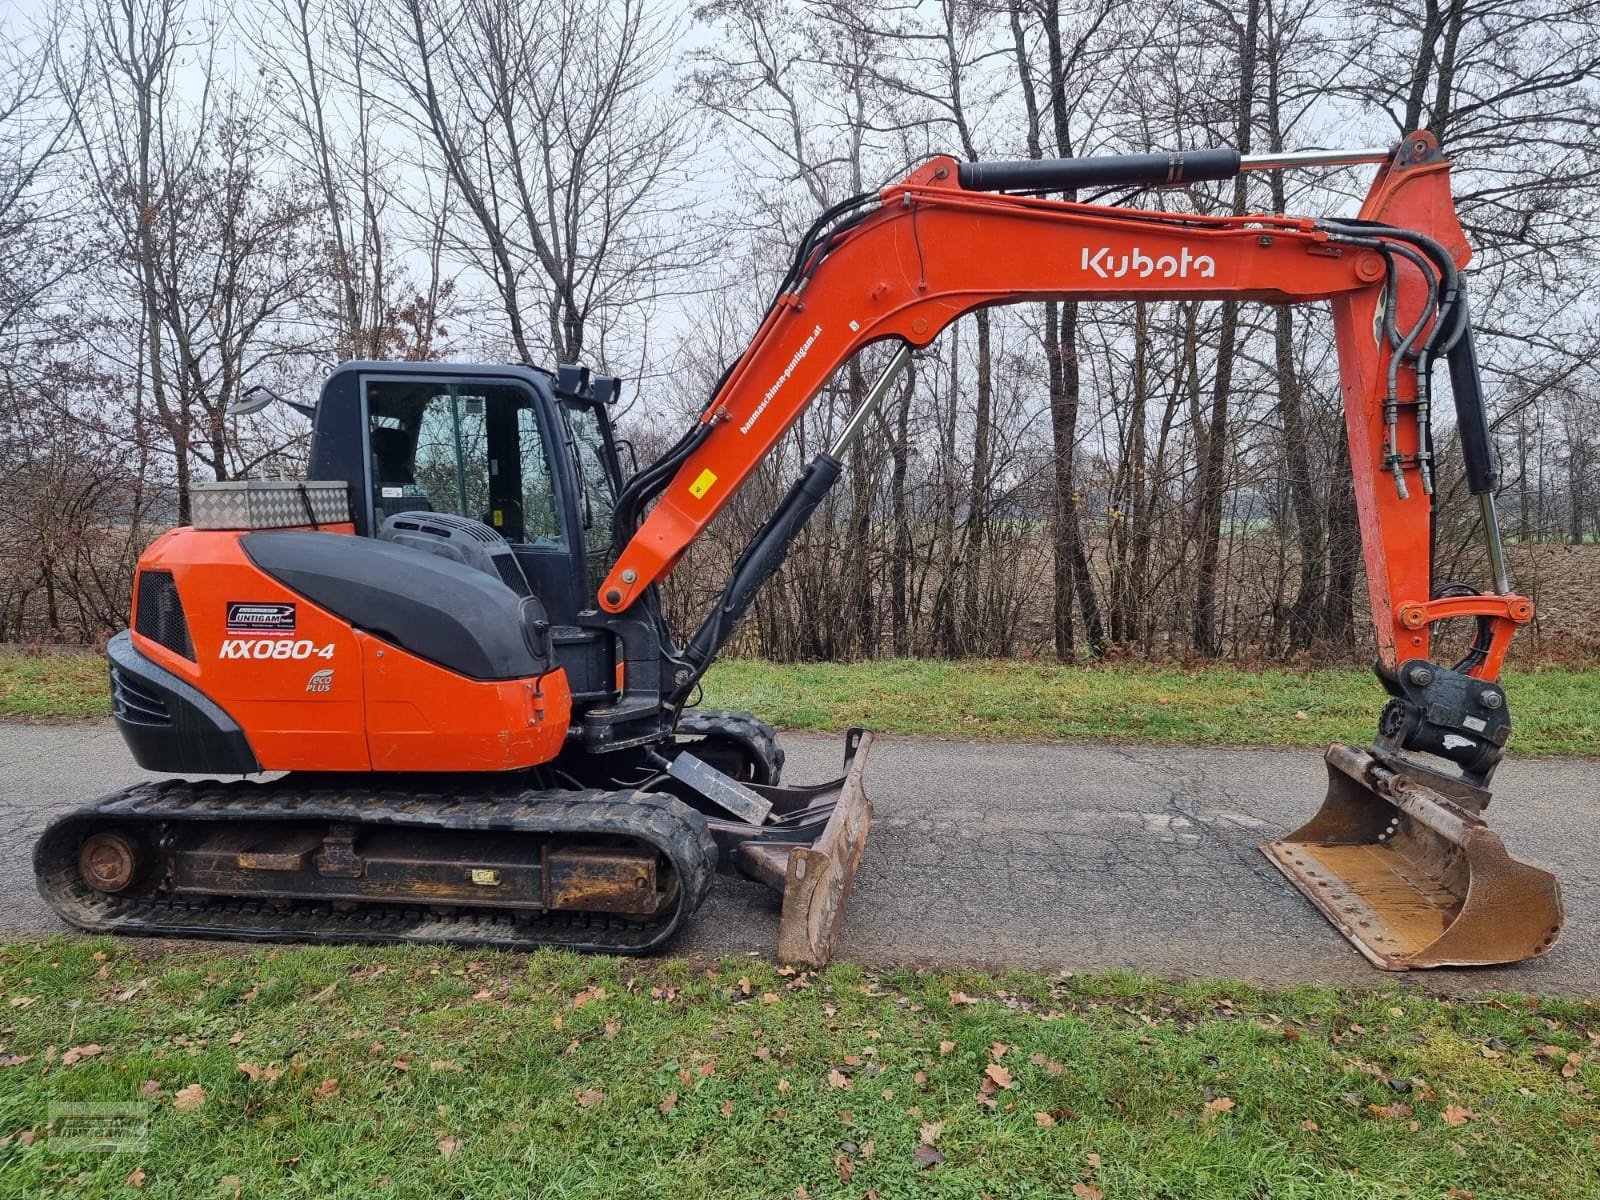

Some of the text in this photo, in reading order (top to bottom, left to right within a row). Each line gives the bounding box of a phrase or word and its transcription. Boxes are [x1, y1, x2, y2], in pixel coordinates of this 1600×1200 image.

[1081, 247, 1215, 278] Kubota
[740, 325, 822, 435] baumaschinen-puntigam.at
[218, 640, 335, 659] KX080-4
